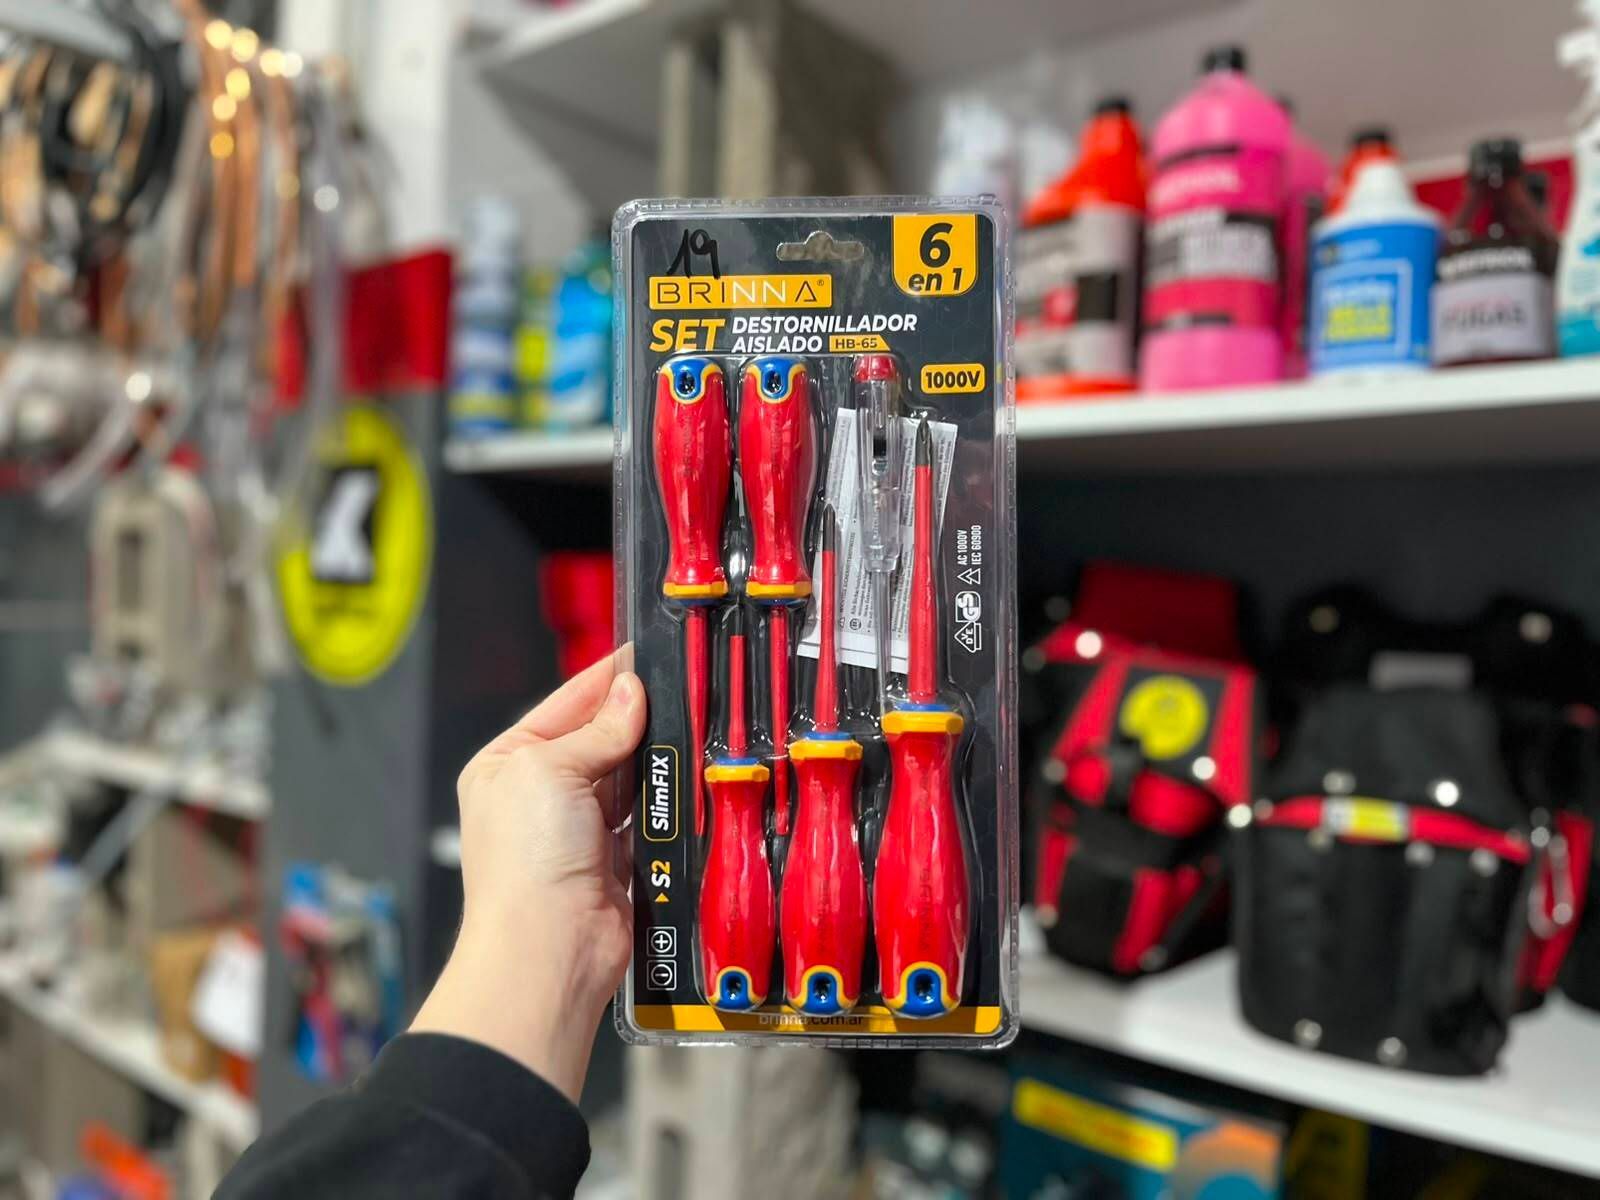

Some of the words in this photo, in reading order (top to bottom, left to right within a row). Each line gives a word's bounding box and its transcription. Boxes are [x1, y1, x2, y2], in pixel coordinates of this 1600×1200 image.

[666, 228, 720, 280] 19
[919, 222, 953, 268] 6
[908, 271, 941, 292] en
[949, 267, 963, 290] 1
[649, 319, 726, 352] SET
[731, 313, 918, 334] DESTORNILLADOR
[731, 335, 823, 353] AISLADO
[835, 337, 878, 349] HB-65
[925, 371, 981, 388] 1000V
[957, 529, 968, 554] 1000V
[957, 555, 968, 565] AC
[971, 552, 982, 565] IEC
[650, 754, 670, 831] SlimFIX
[651, 859, 671, 888] S2
